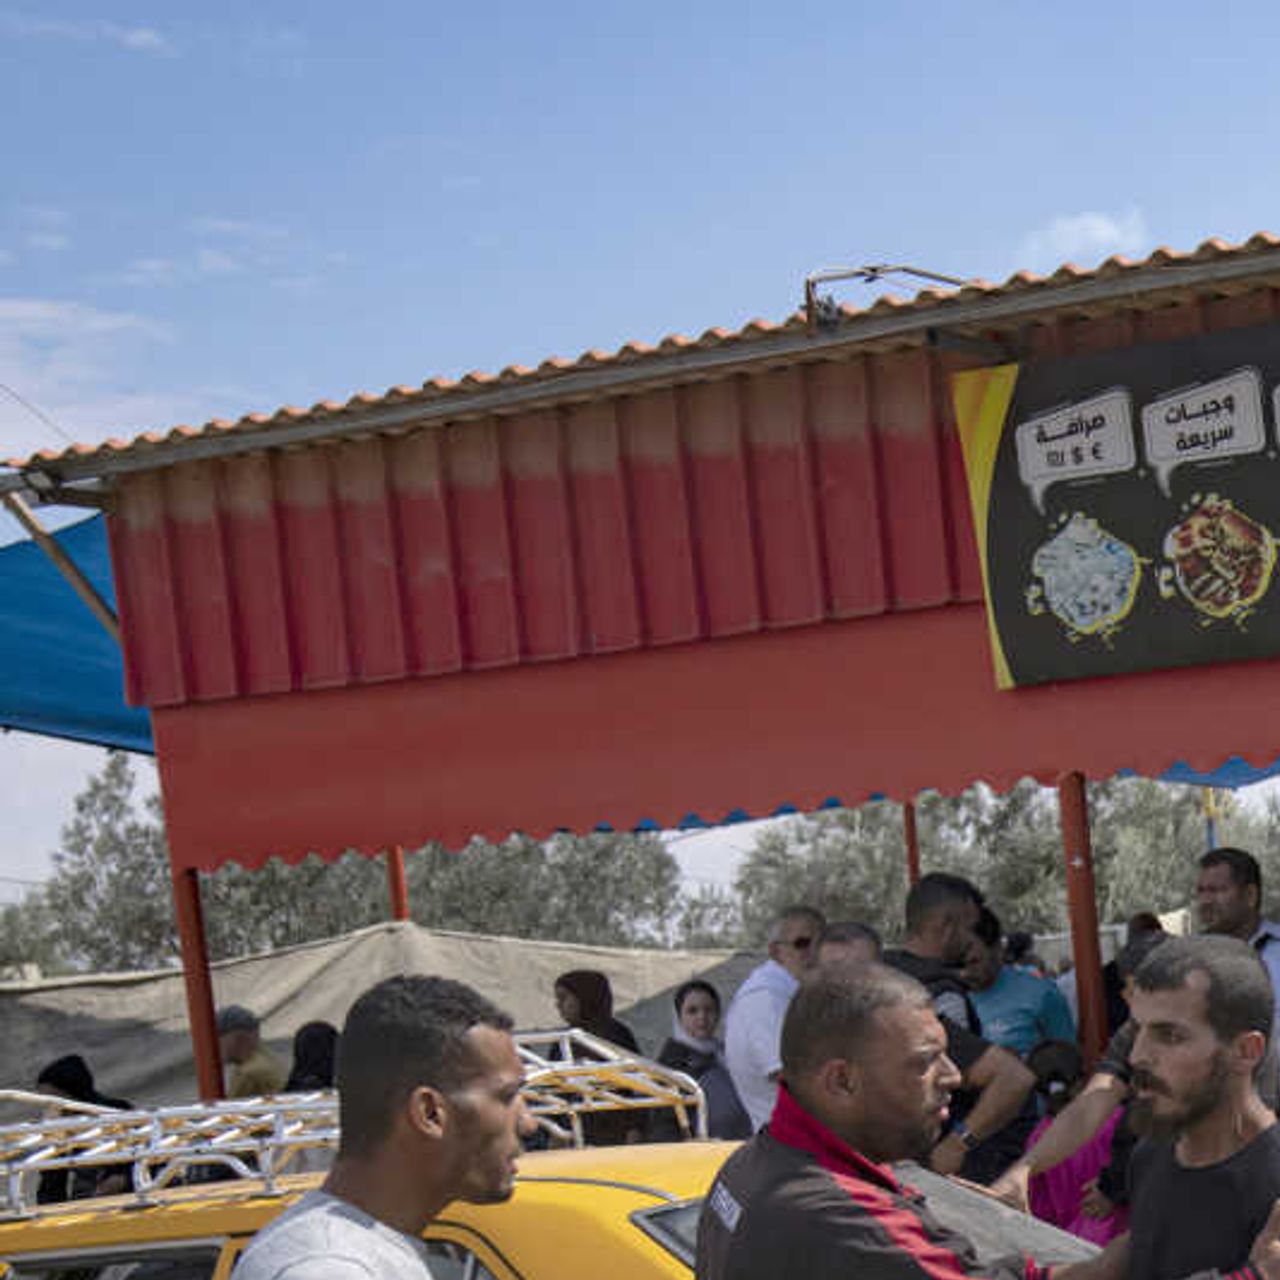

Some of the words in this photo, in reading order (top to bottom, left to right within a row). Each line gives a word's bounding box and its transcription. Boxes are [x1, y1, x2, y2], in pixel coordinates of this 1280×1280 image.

[1165, 394, 1235, 424] وجبات
[1036, 411, 1105, 444] صرافة
[1175, 425, 1234, 452] سريعة
